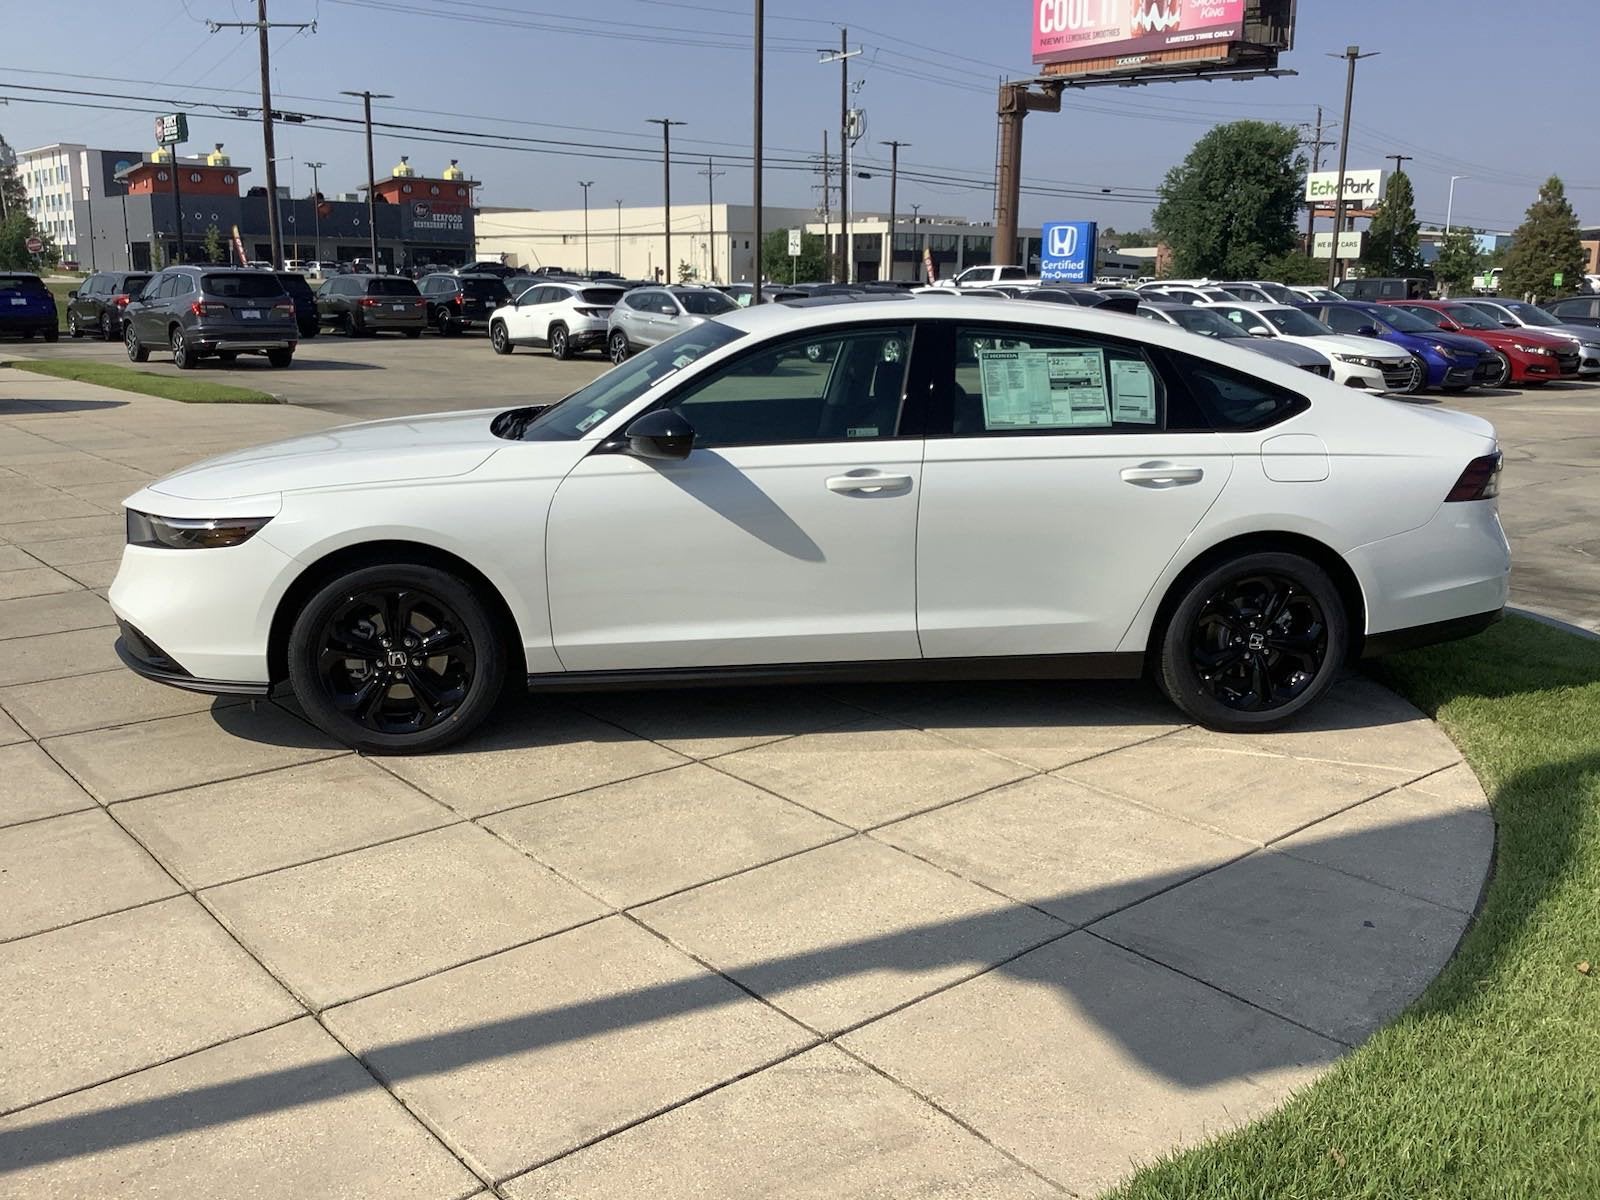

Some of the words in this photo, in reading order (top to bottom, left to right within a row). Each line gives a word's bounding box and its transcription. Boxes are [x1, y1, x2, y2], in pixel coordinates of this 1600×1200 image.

[1040, 0, 1096, 33] COOL
[1165, 34, 1195, 44] LIMITED
[1195, 32, 1214, 41] TIME
[1214, 30, 1235, 38] ONLY
[432, 214, 462, 222] SEAFOOD
[1042, 260, 1085, 270] Certified
[1041, 271, 1084, 279] Pre-Owned
